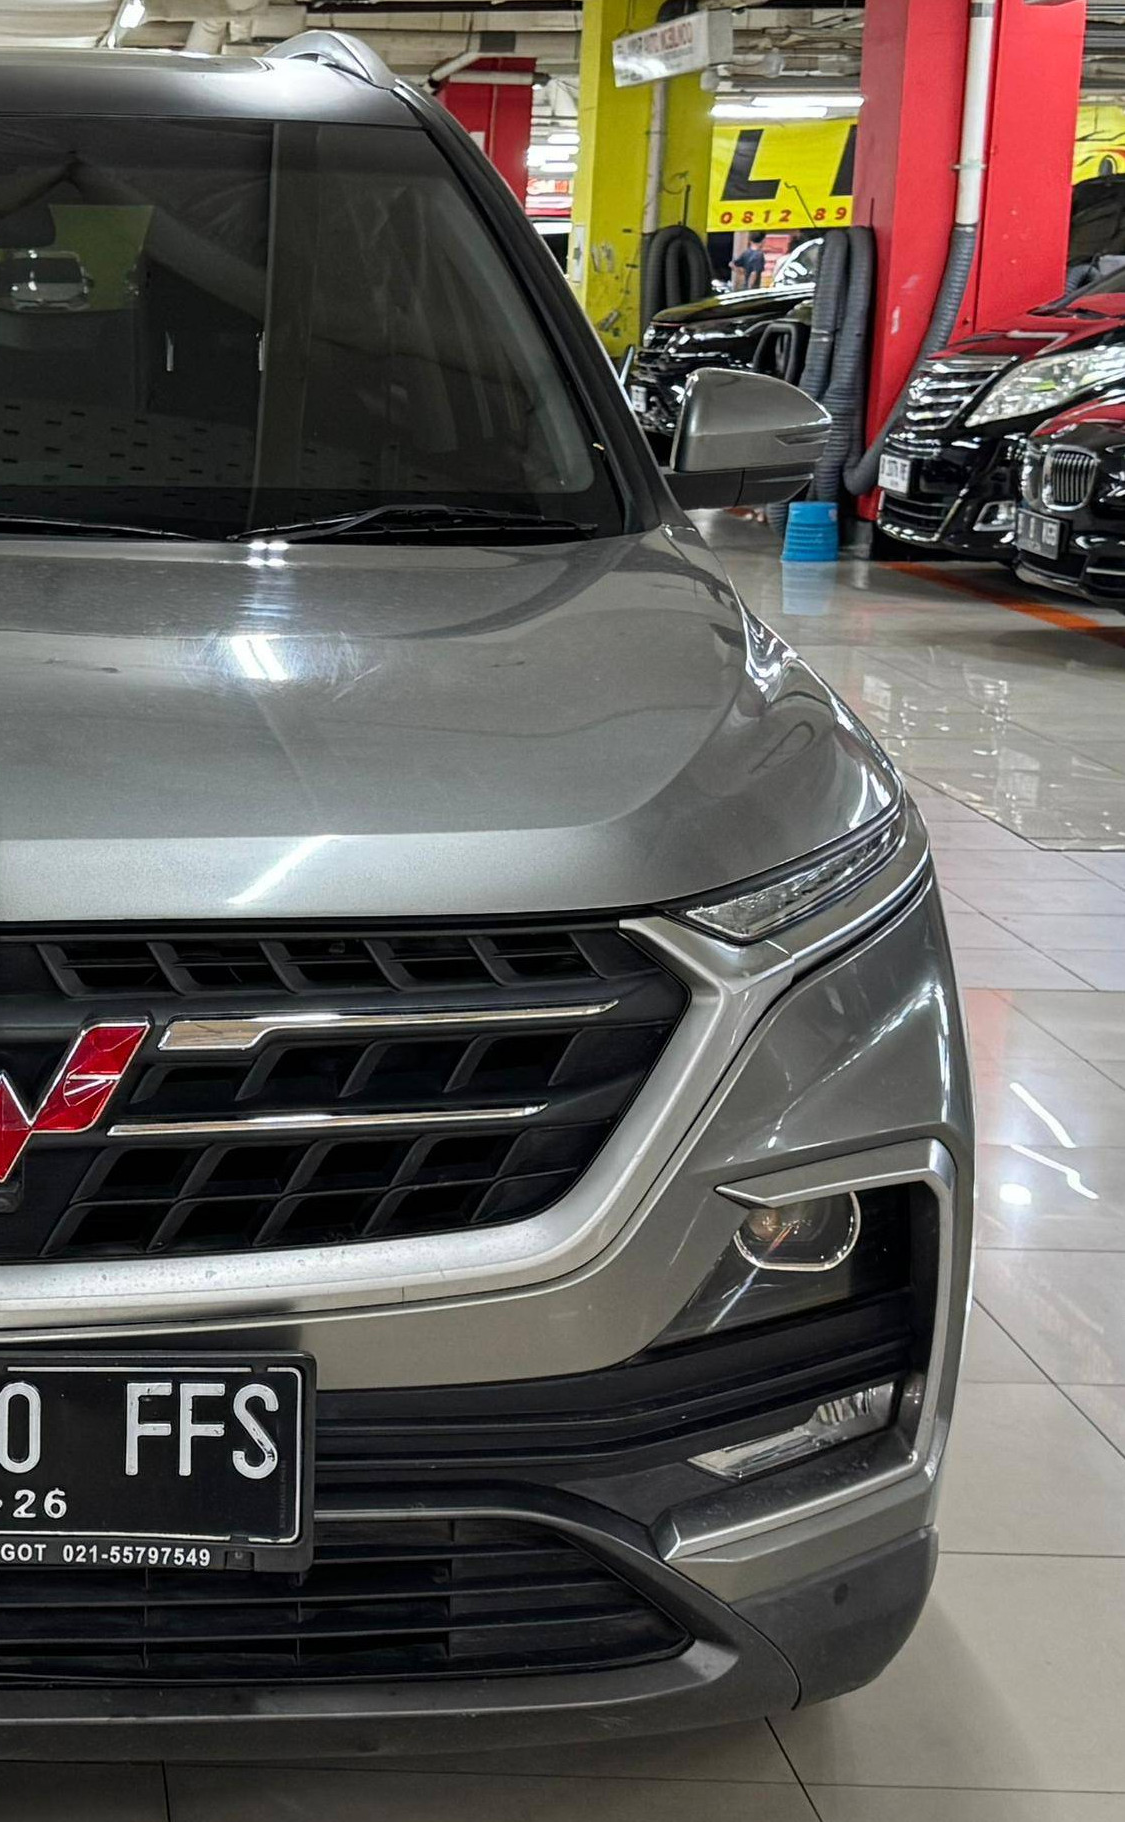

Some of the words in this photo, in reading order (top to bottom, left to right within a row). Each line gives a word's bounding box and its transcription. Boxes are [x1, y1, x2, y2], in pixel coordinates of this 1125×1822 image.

[720, 209, 792, 225] 0812
[813, 207, 847, 221] 89
[125, 1382, 279, 1480] FFS
[62, 1544, 211, 1567] 021-55797549
